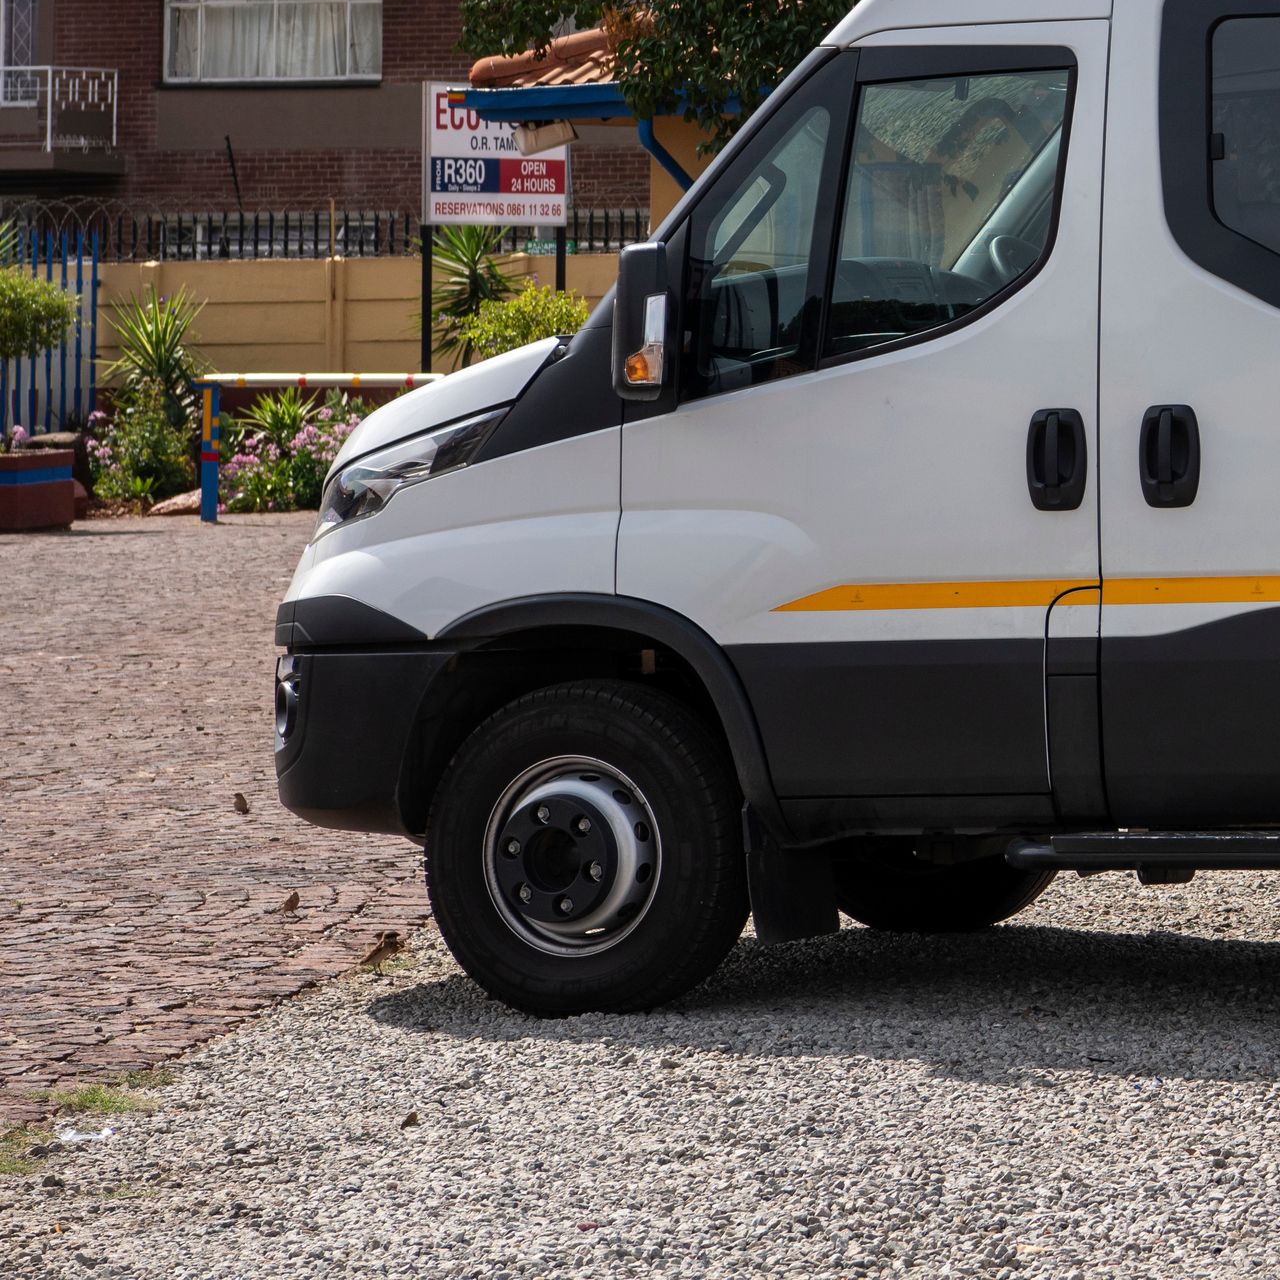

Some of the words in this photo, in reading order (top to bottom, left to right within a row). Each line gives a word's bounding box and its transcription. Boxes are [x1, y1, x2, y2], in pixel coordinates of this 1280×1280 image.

[470, 136, 491, 151] O.R.
[493, 136, 519, 151] TAM
[444, 158, 485, 184] R360
[521, 161, 547, 175] OPEN
[511, 179, 521, 192] 24
[524, 179, 556, 193] HOURS
[434, 202, 505, 216] RESERVATIONS
[506, 203, 526, 216] 0861
[529, 203, 537, 216] 11
[539, 203, 550, 216] 32
[552, 203, 562, 216] 66
